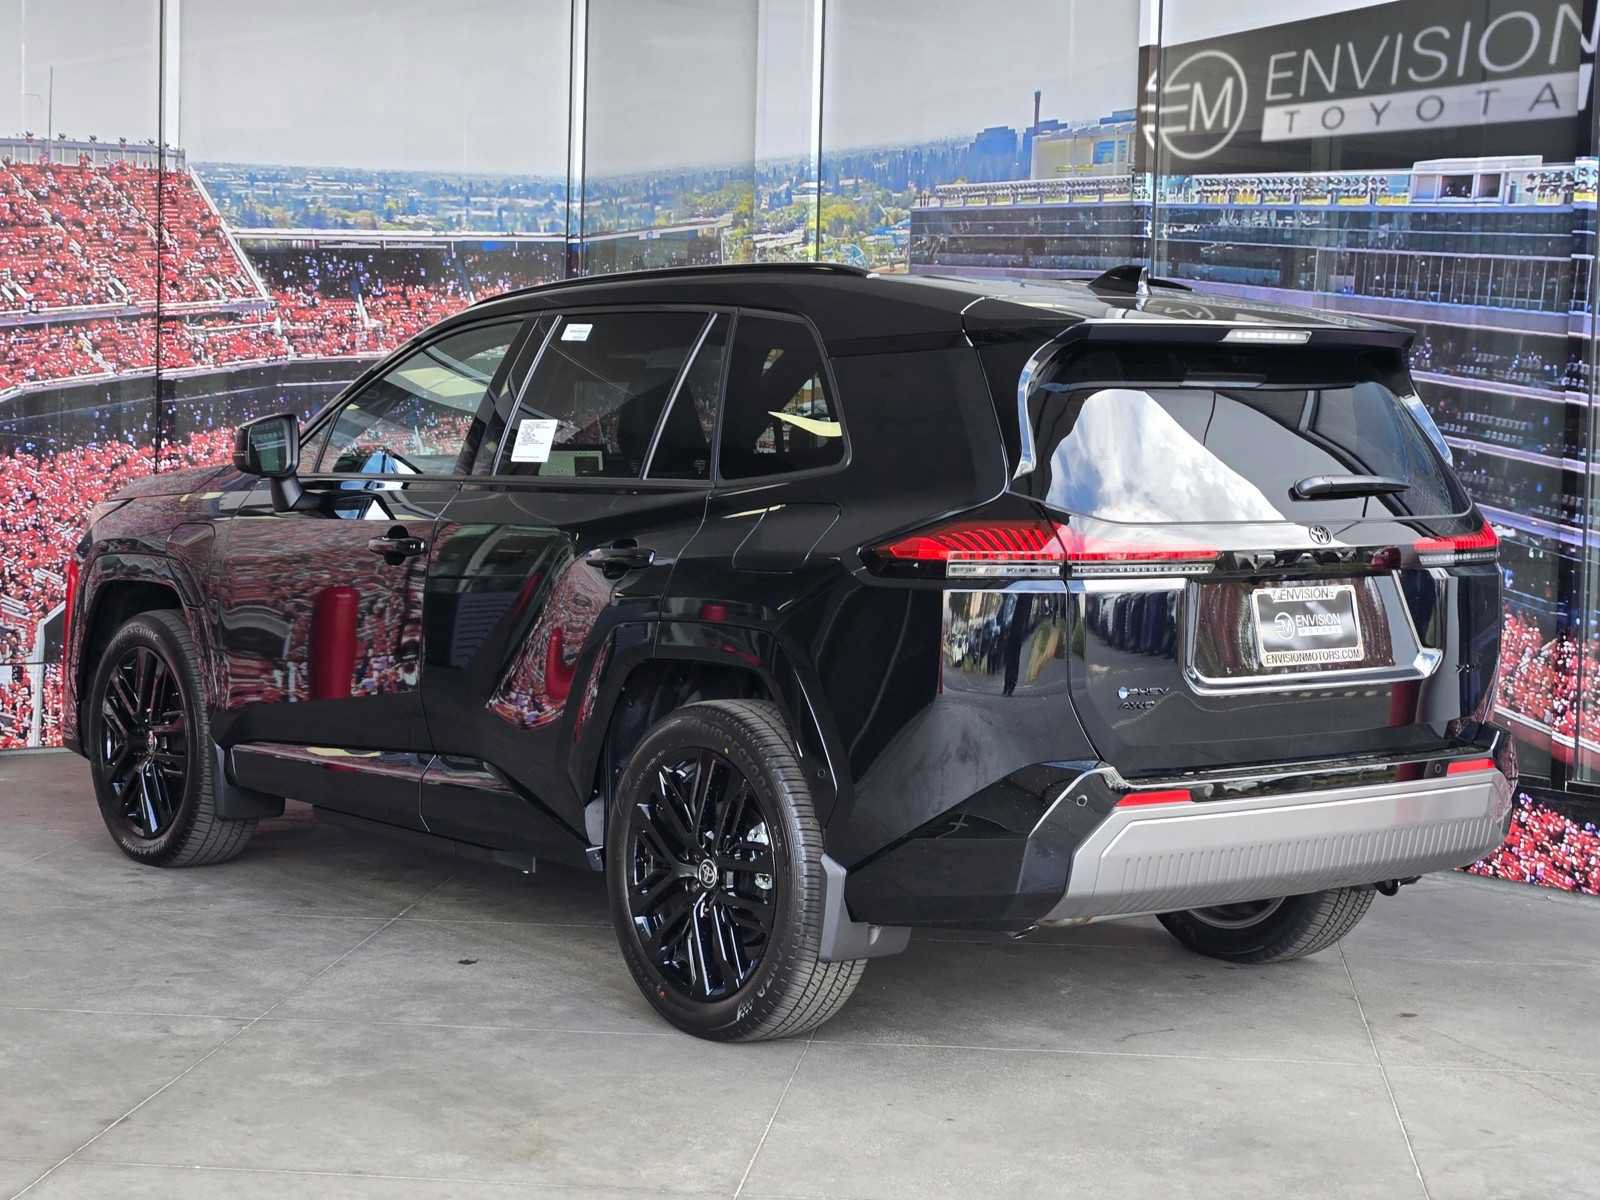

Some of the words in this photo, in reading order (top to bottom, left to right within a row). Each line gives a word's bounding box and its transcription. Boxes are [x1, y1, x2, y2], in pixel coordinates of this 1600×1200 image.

[1265, 3, 1600, 101] ENVISION
[1283, 82, 1561, 134] TOYOTA
[1280, 588, 1329, 600] ENVISION
[1295, 613, 1341, 627] ENVISION
[1266, 649, 1360, 664] ENVISIONMOTORS.COM
